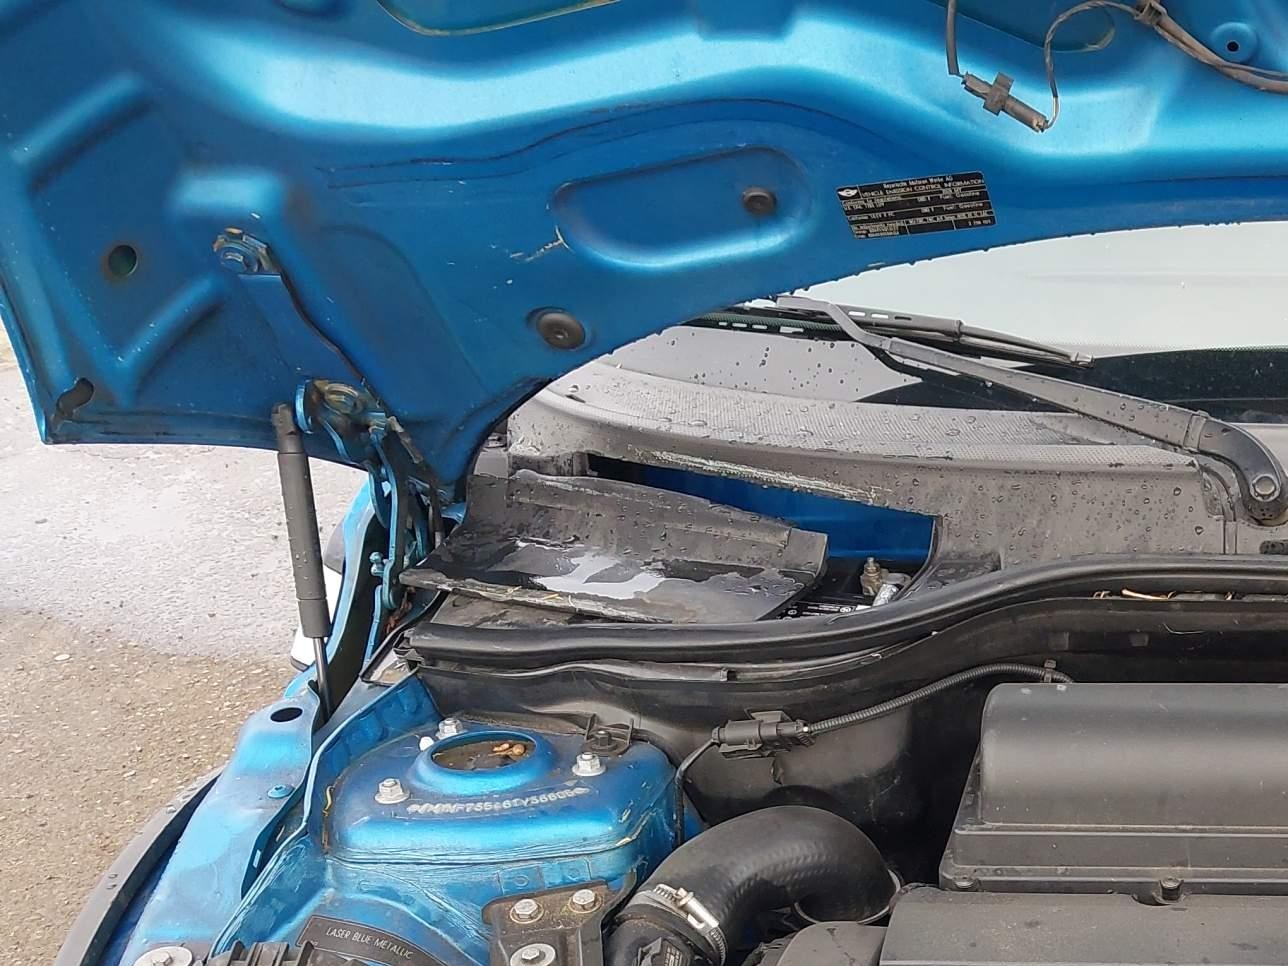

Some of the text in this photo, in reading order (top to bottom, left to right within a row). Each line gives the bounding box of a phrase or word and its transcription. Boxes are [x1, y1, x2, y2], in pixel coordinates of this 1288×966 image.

[862, 190, 884, 198] VEHICLE
[885, 187, 913, 195] EMISSION
[914, 184, 941, 192] CONTROL
[944, 179, 985, 189] INFORMATION
[326, 927, 414, 960] LASER BLUE METALLIC
